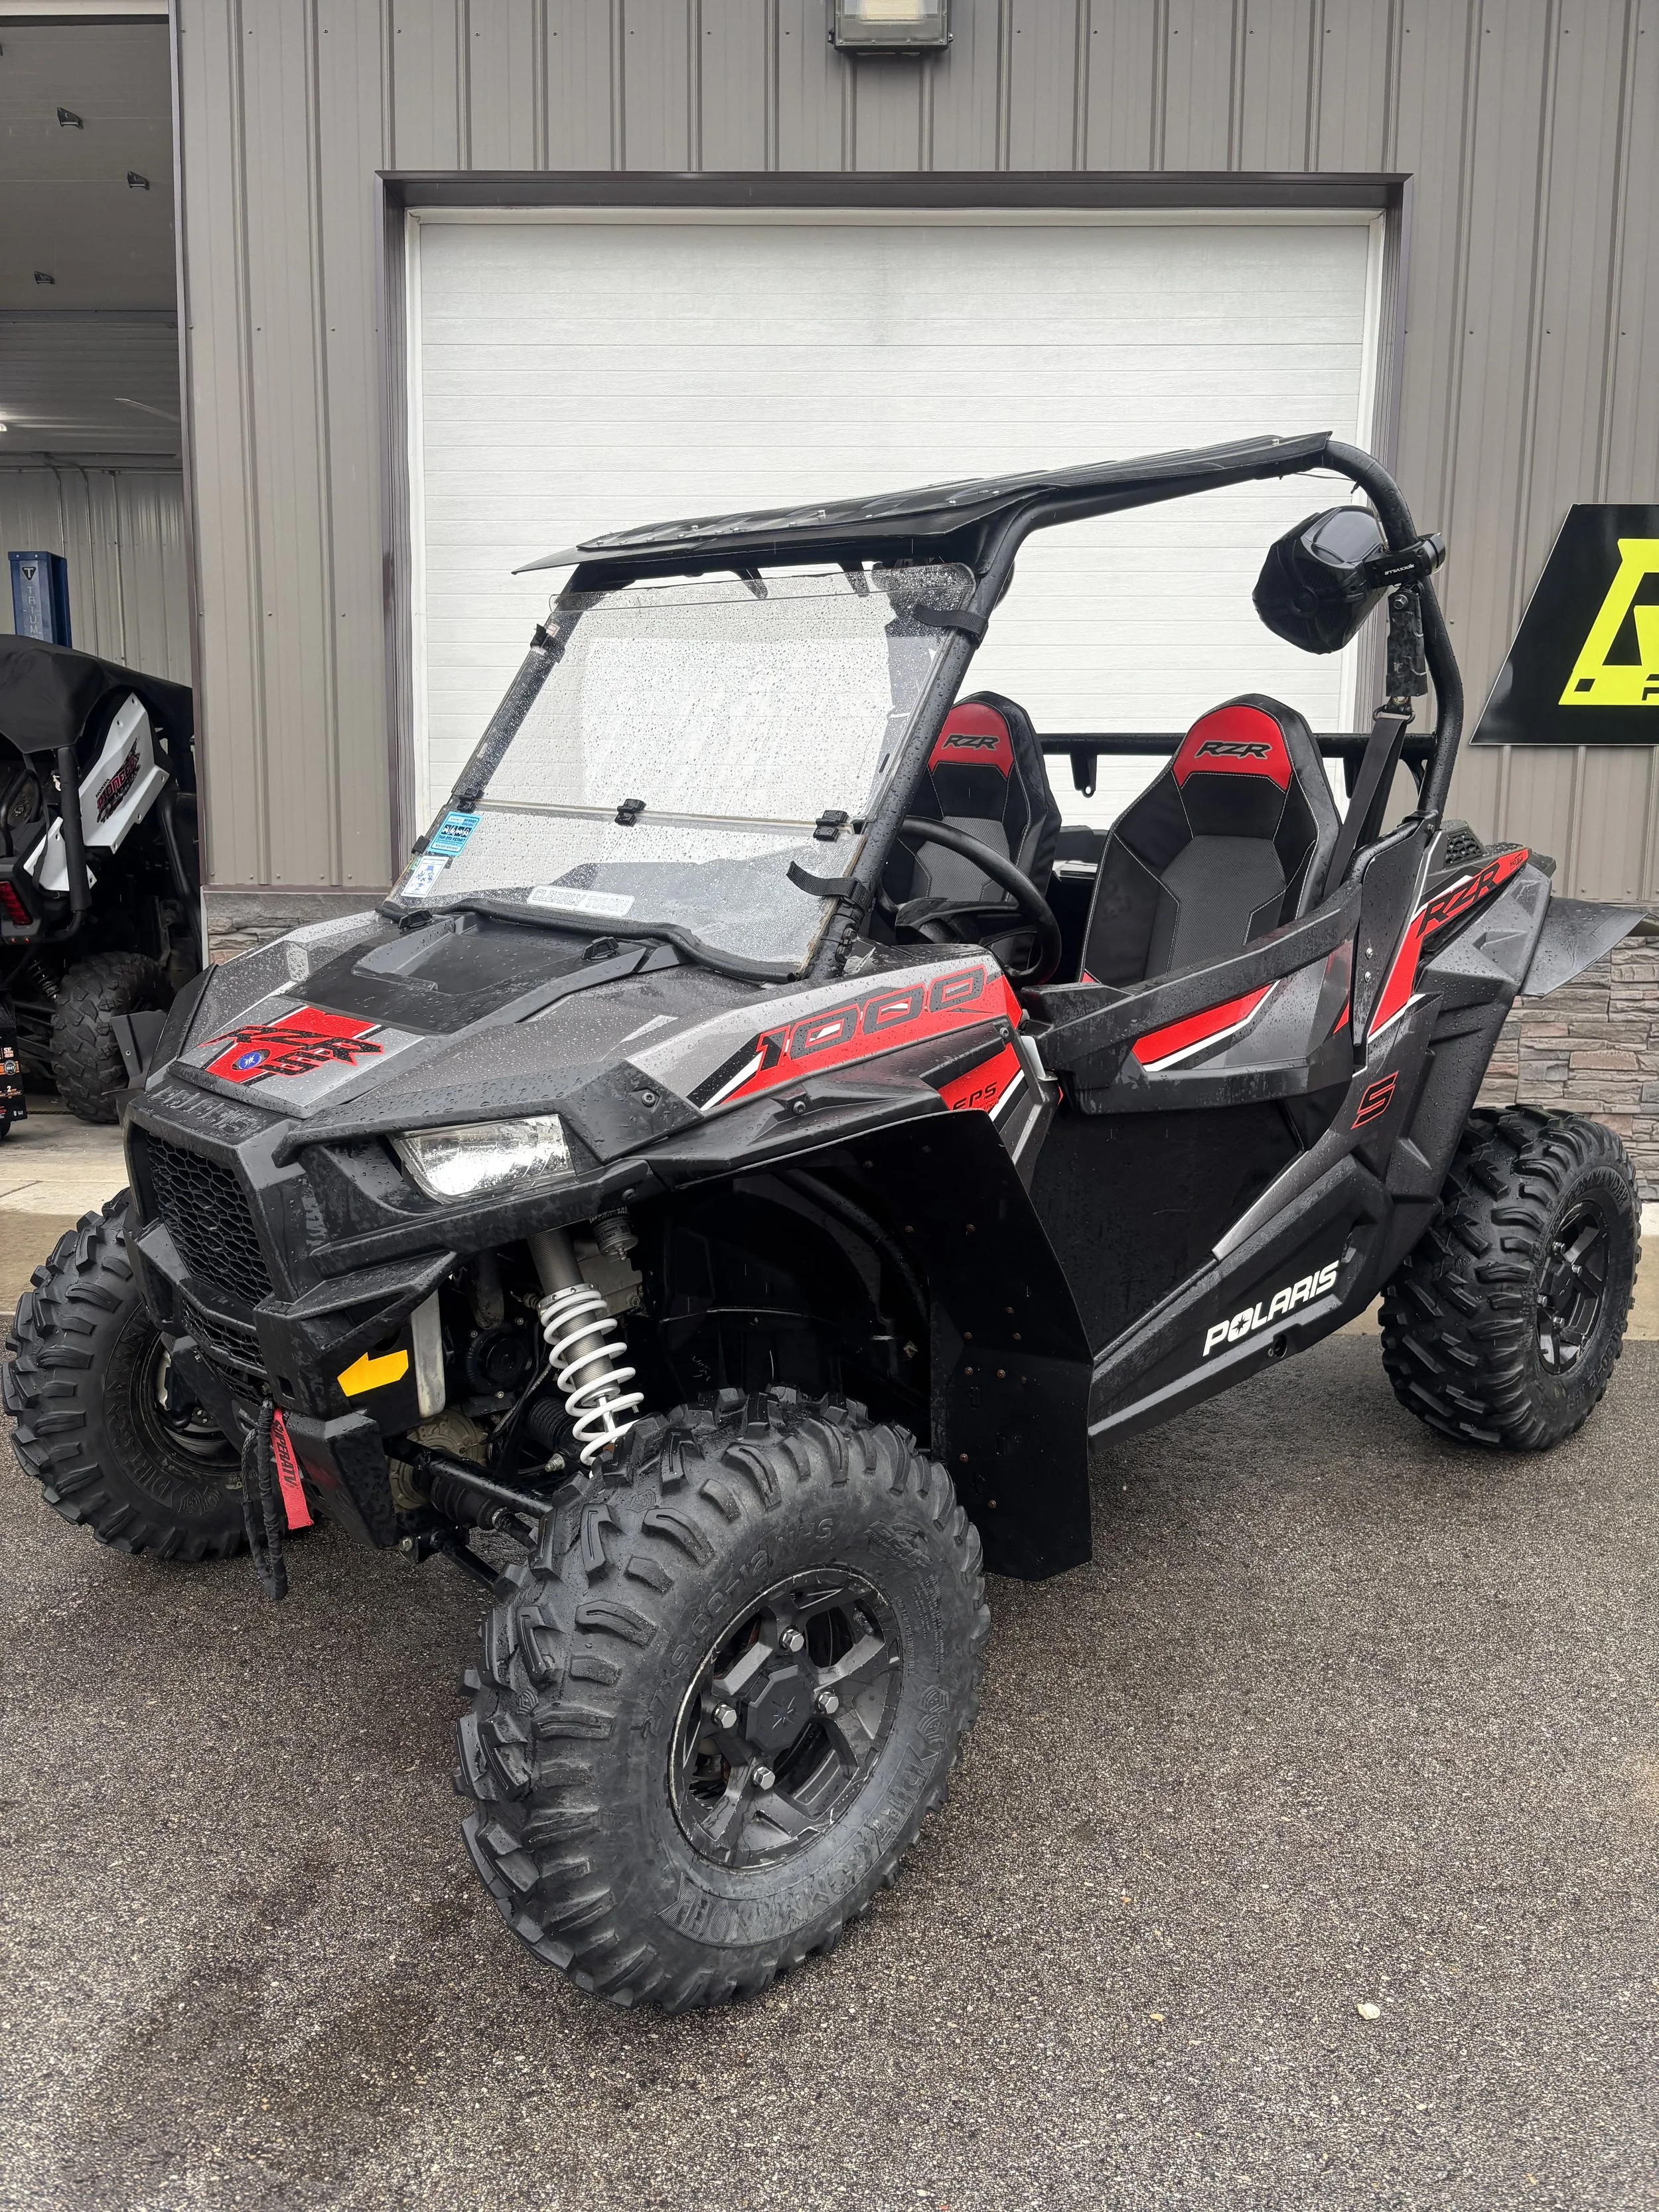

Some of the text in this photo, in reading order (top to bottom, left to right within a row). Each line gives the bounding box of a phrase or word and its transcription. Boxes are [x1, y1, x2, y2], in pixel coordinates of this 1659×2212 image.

[942, 734, 1000, 751] RZR
[1194, 741, 1272, 759] RZR
[95, 778, 110, 798] HONDA
[532, 889, 630, 913] CLEARLY TOUGH
[1415, 862, 1500, 939] RZR
[756, 964, 988, 1070] 1000
[953, 1081, 997, 1110] EPS
[1351, 1070, 1399, 1130] S
[1202, 1260, 1339, 1357] POLARIS
